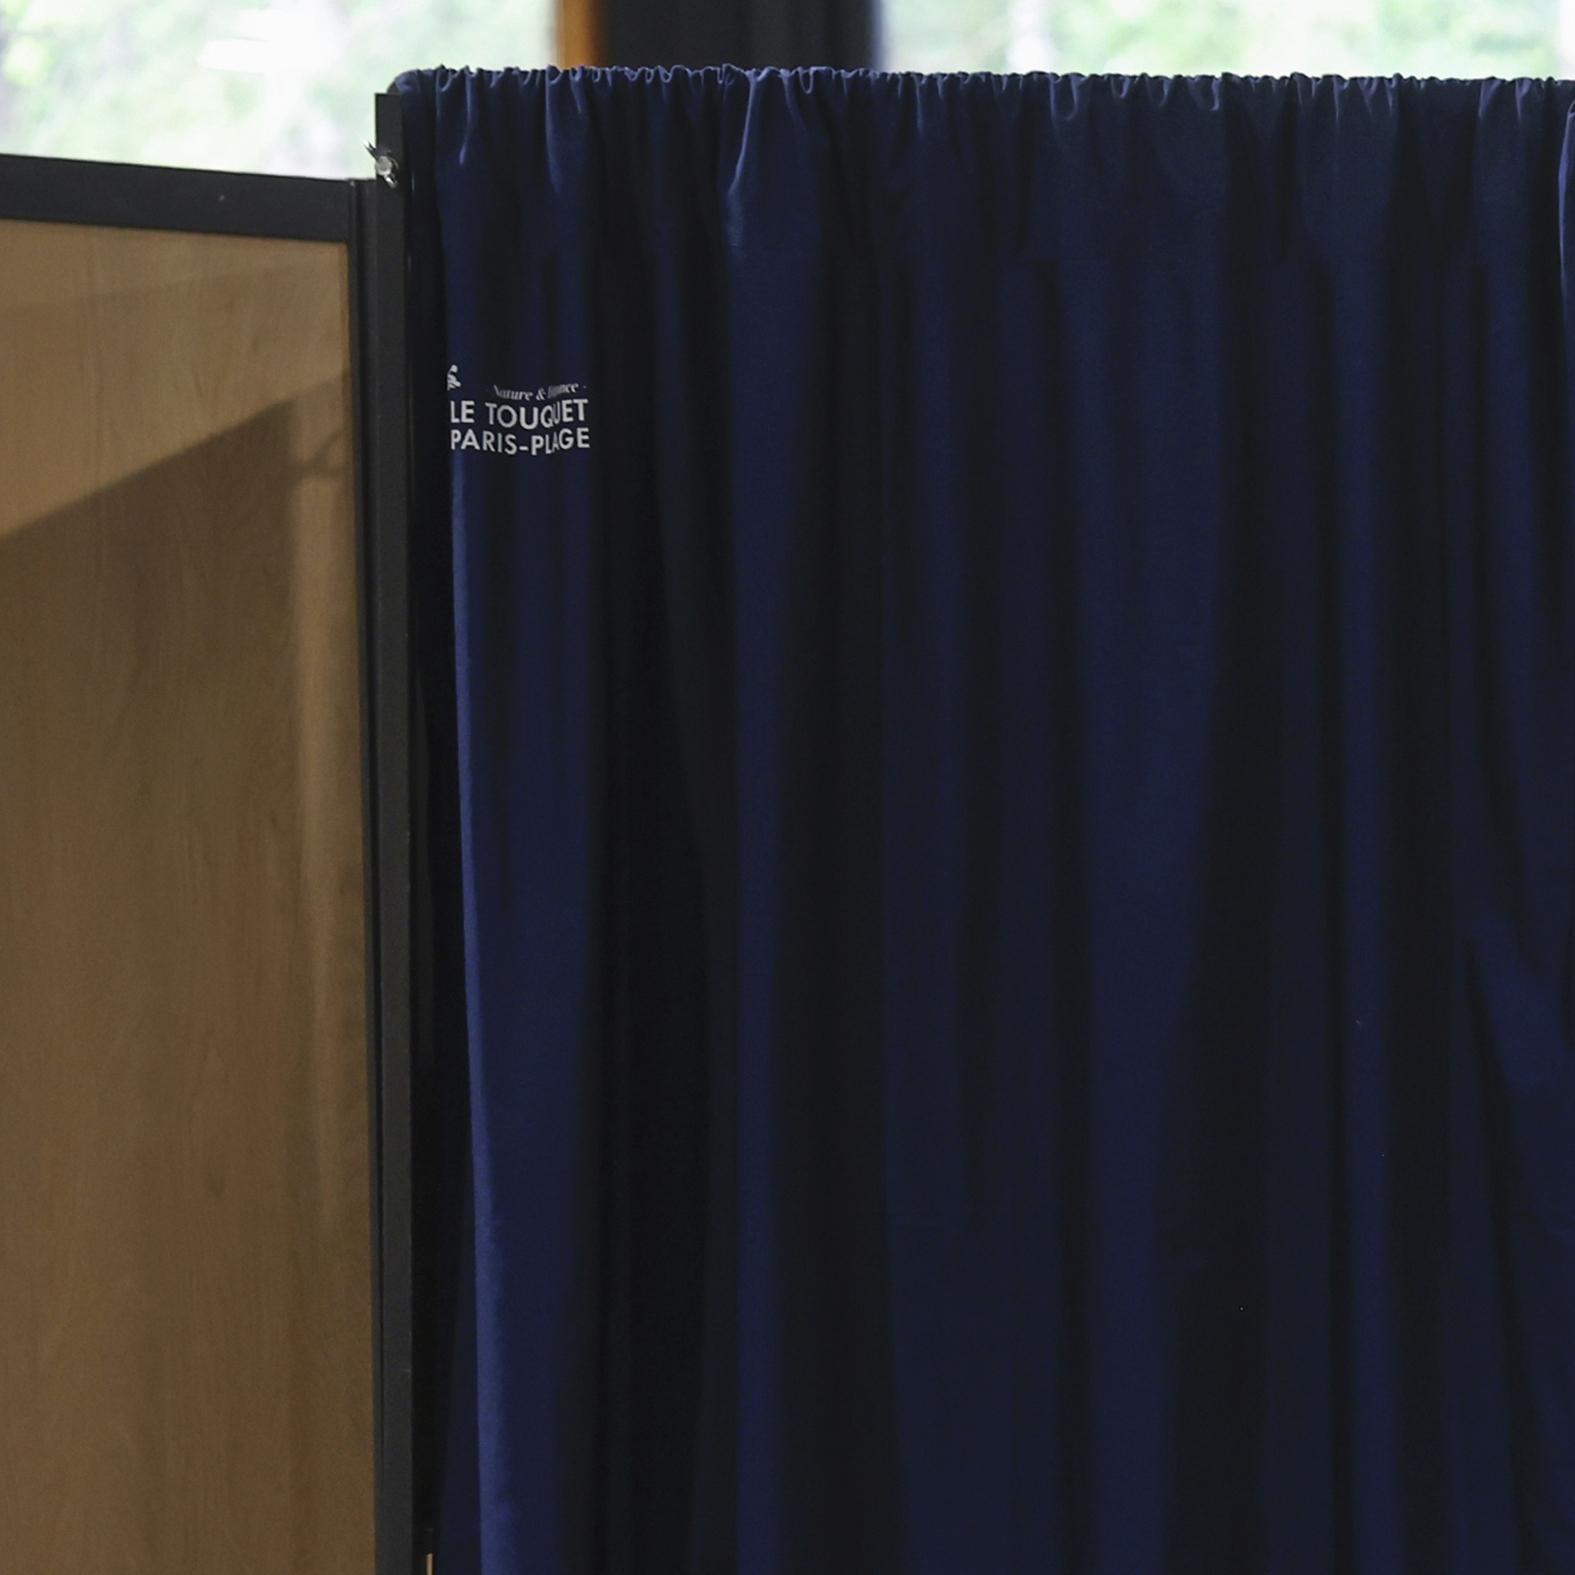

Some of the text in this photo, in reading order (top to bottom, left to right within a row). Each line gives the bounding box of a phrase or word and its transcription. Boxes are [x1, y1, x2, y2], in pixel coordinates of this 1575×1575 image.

[451, 399, 588, 429] LE TOUQUET
[451, 427, 590, 455] PARIS-PLAGE
